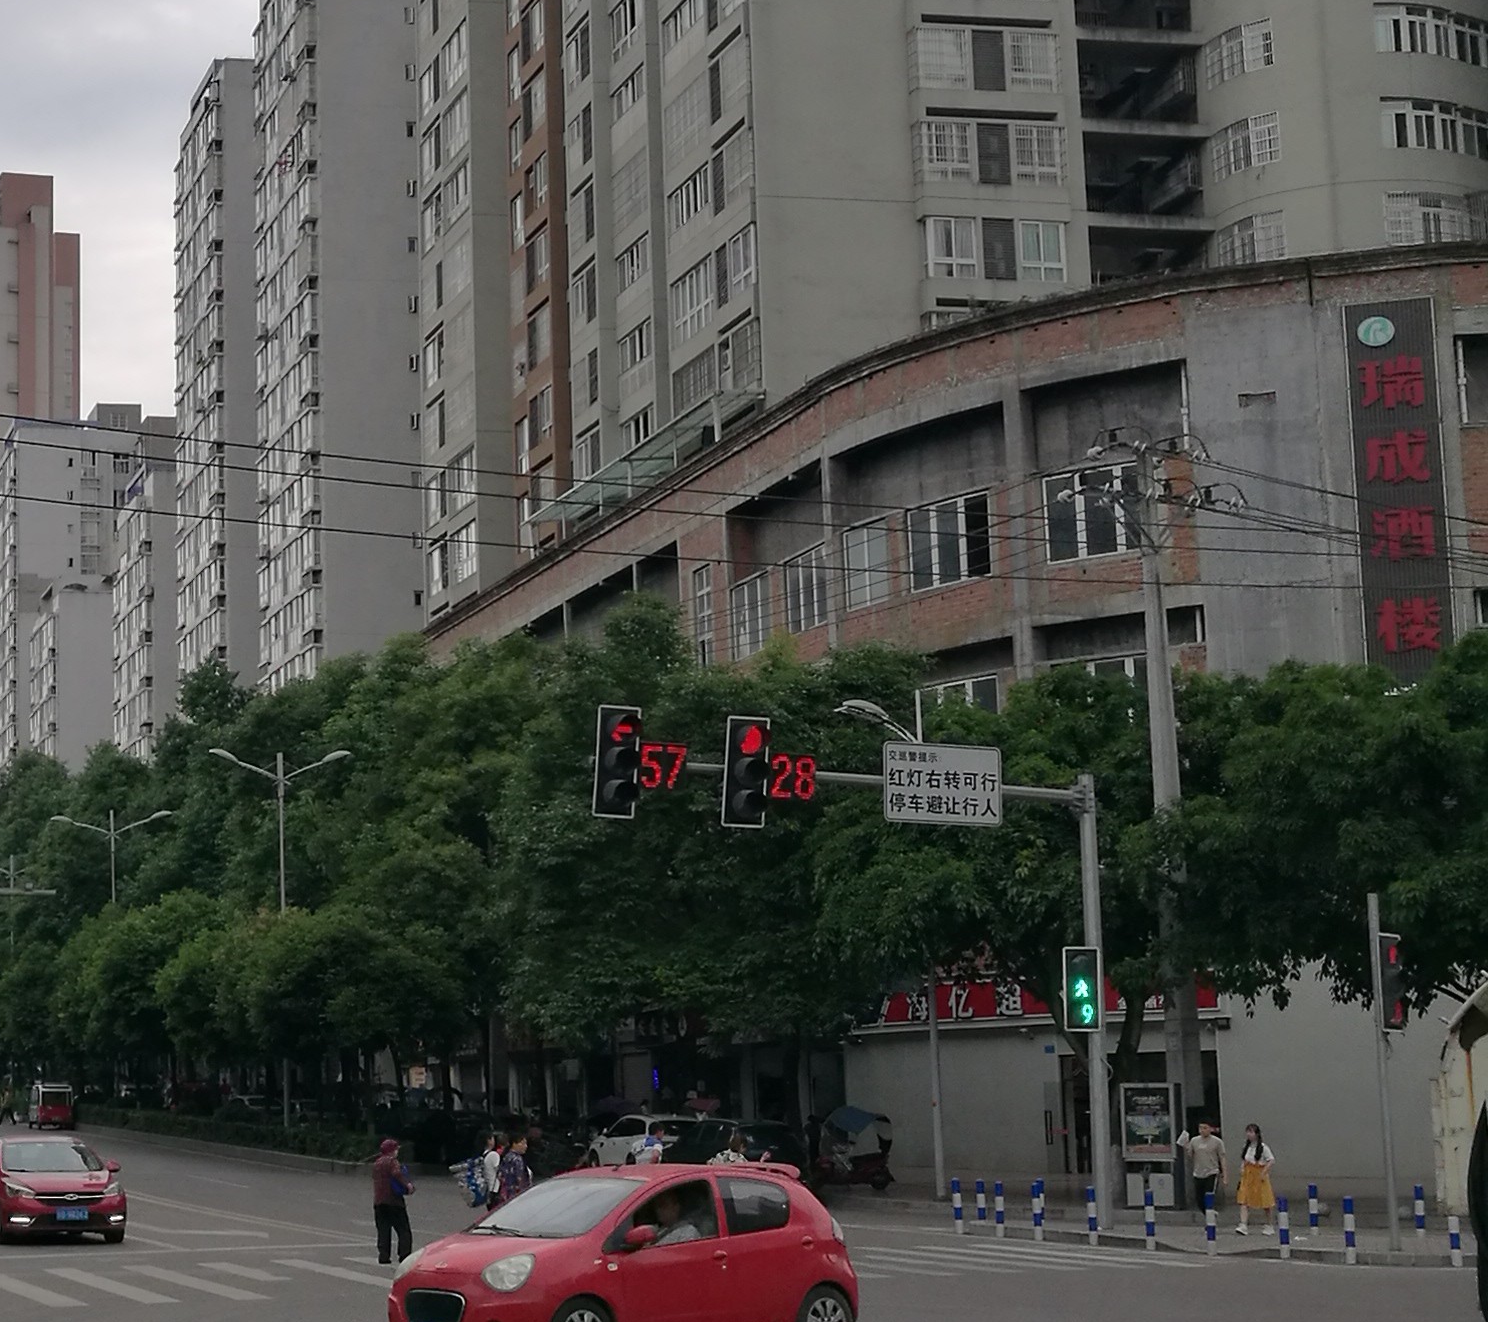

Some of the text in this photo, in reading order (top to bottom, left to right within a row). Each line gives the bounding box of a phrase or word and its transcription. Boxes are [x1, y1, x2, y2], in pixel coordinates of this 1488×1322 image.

[1357, 353, 1442, 653] 瑞成酒楼
[640, 744, 688, 789] 57
[770, 754, 817, 800] 28
[888, 768, 998, 792] 红灯右转可行
[888, 793, 998, 818] 停车避让行人
[1082, 1003, 1094, 1024] 9
